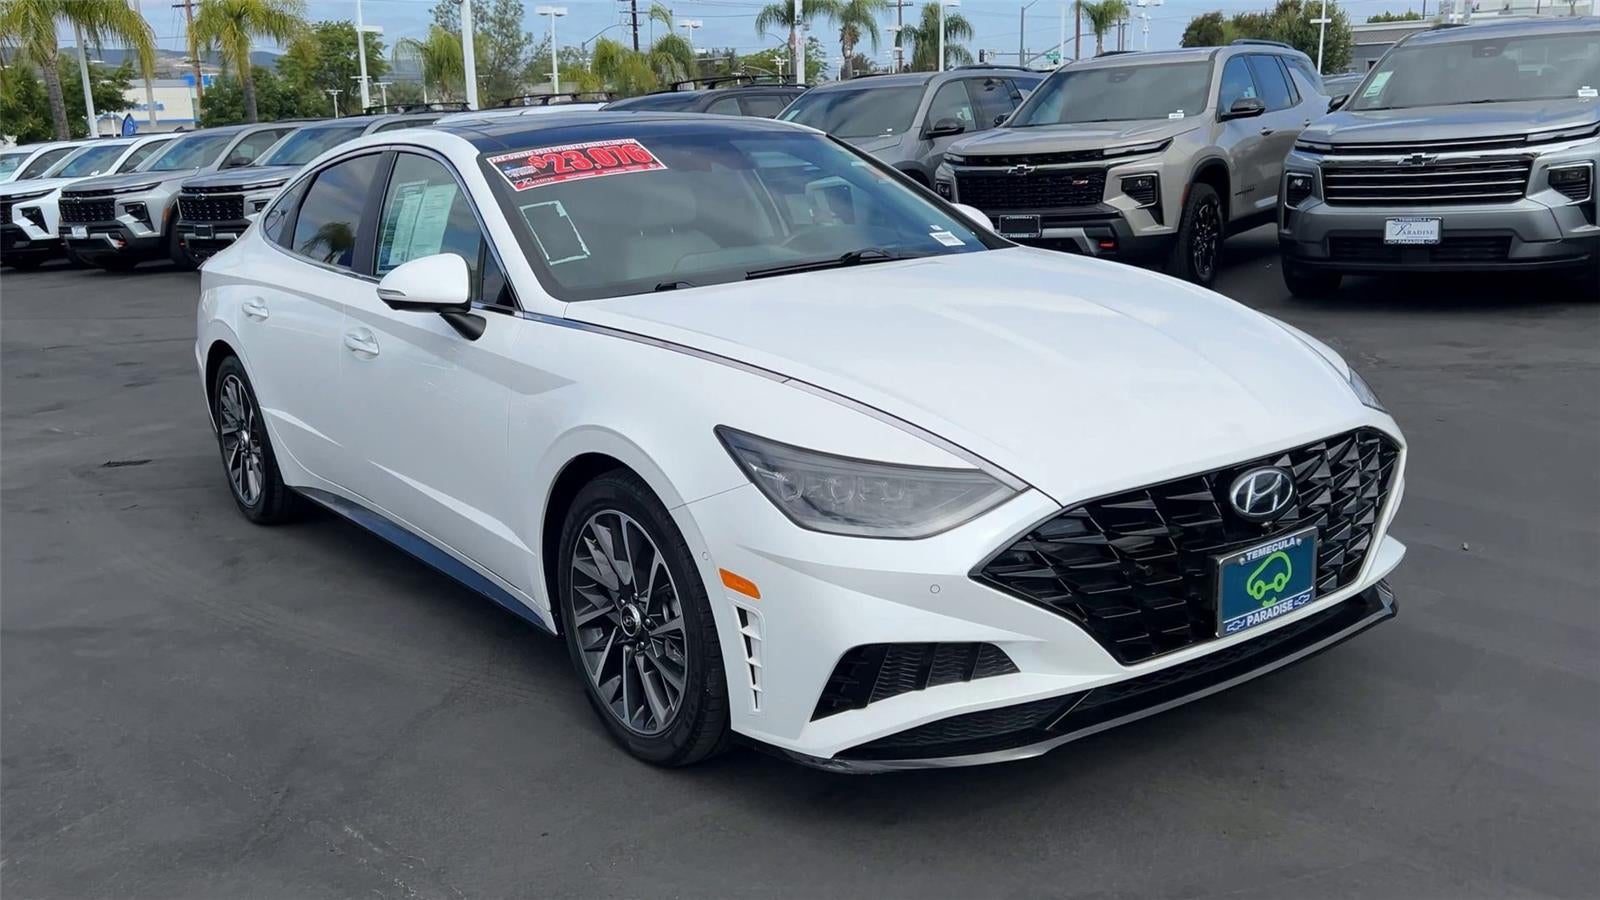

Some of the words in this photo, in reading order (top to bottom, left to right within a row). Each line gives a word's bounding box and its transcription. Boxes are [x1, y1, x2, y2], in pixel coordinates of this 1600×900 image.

[528, 144, 653, 173] $23,076
[1393, 223, 1434, 236] PARADISE
[1246, 537, 1295, 560] TEMECULA
[1246, 600, 1294, 626] PARADISE
